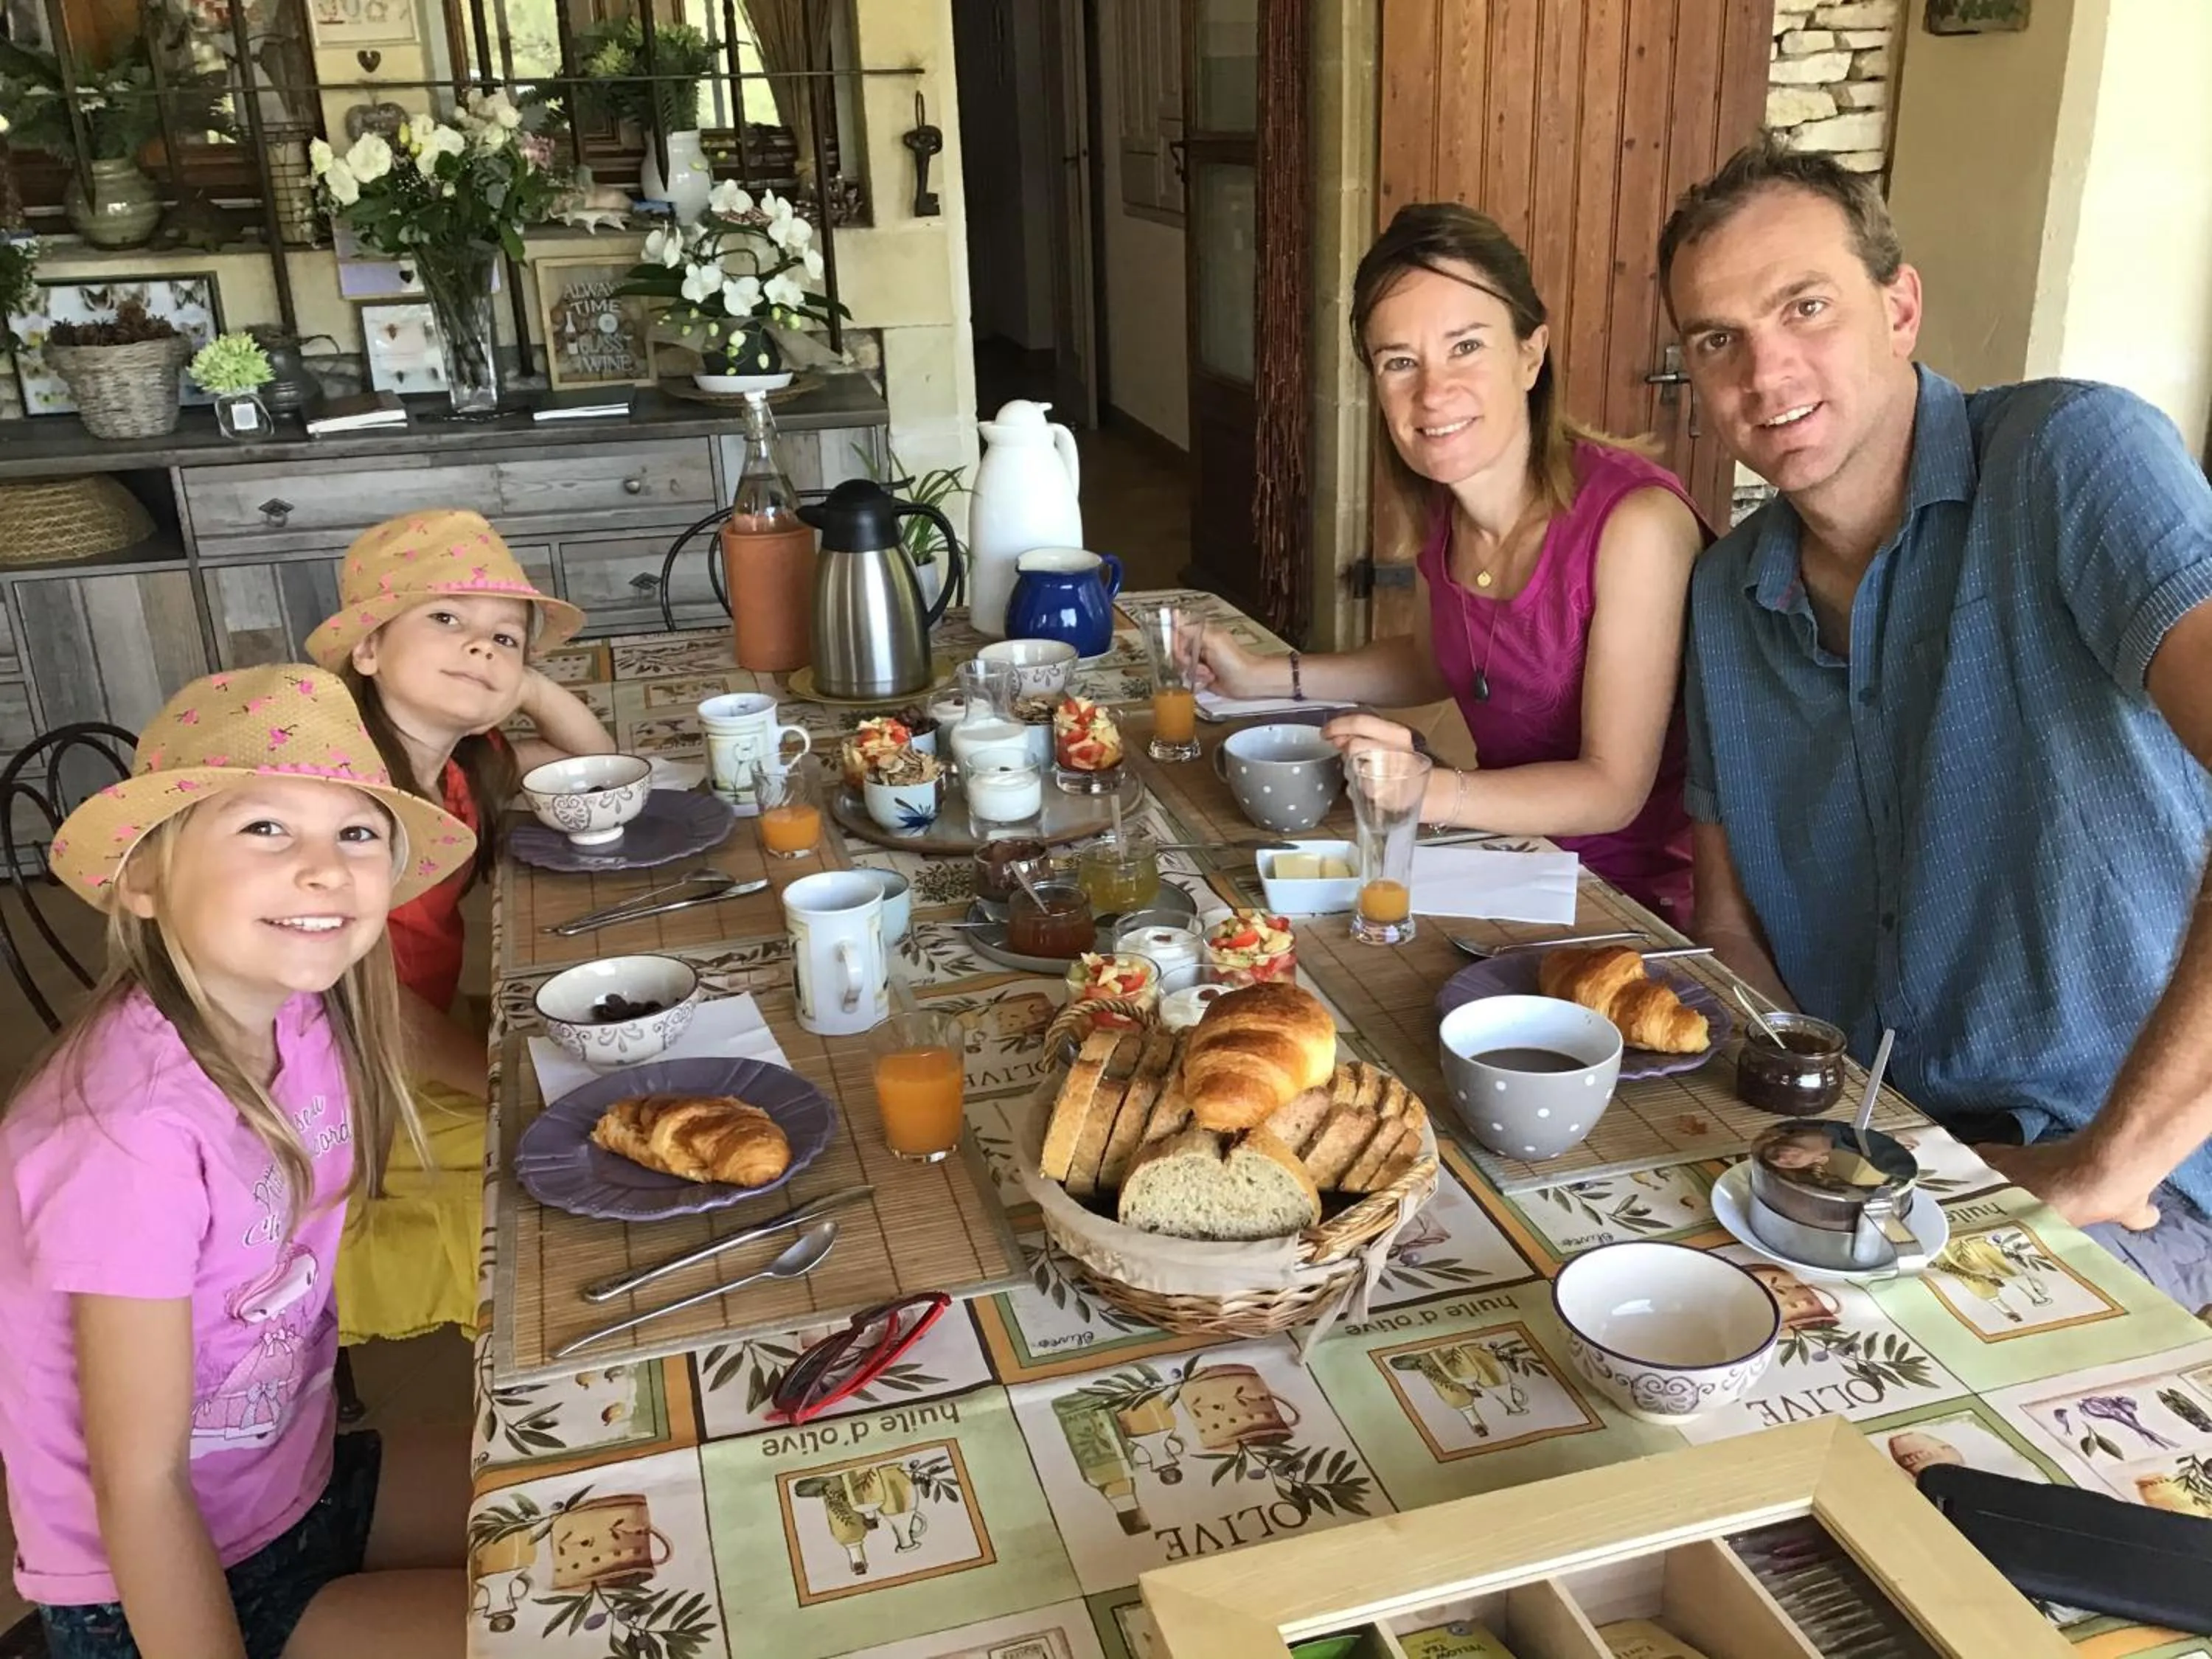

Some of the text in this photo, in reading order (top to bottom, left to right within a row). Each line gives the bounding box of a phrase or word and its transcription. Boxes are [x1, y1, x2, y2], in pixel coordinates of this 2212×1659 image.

[570, 299, 622, 316] TIME
[1444, 1294, 1520, 1318] huile
[1745, 1378, 1885, 1427] OLIVE
[762, 1402, 960, 1457] huile d'olive
[1154, 1500, 1310, 1562] OLIVE
